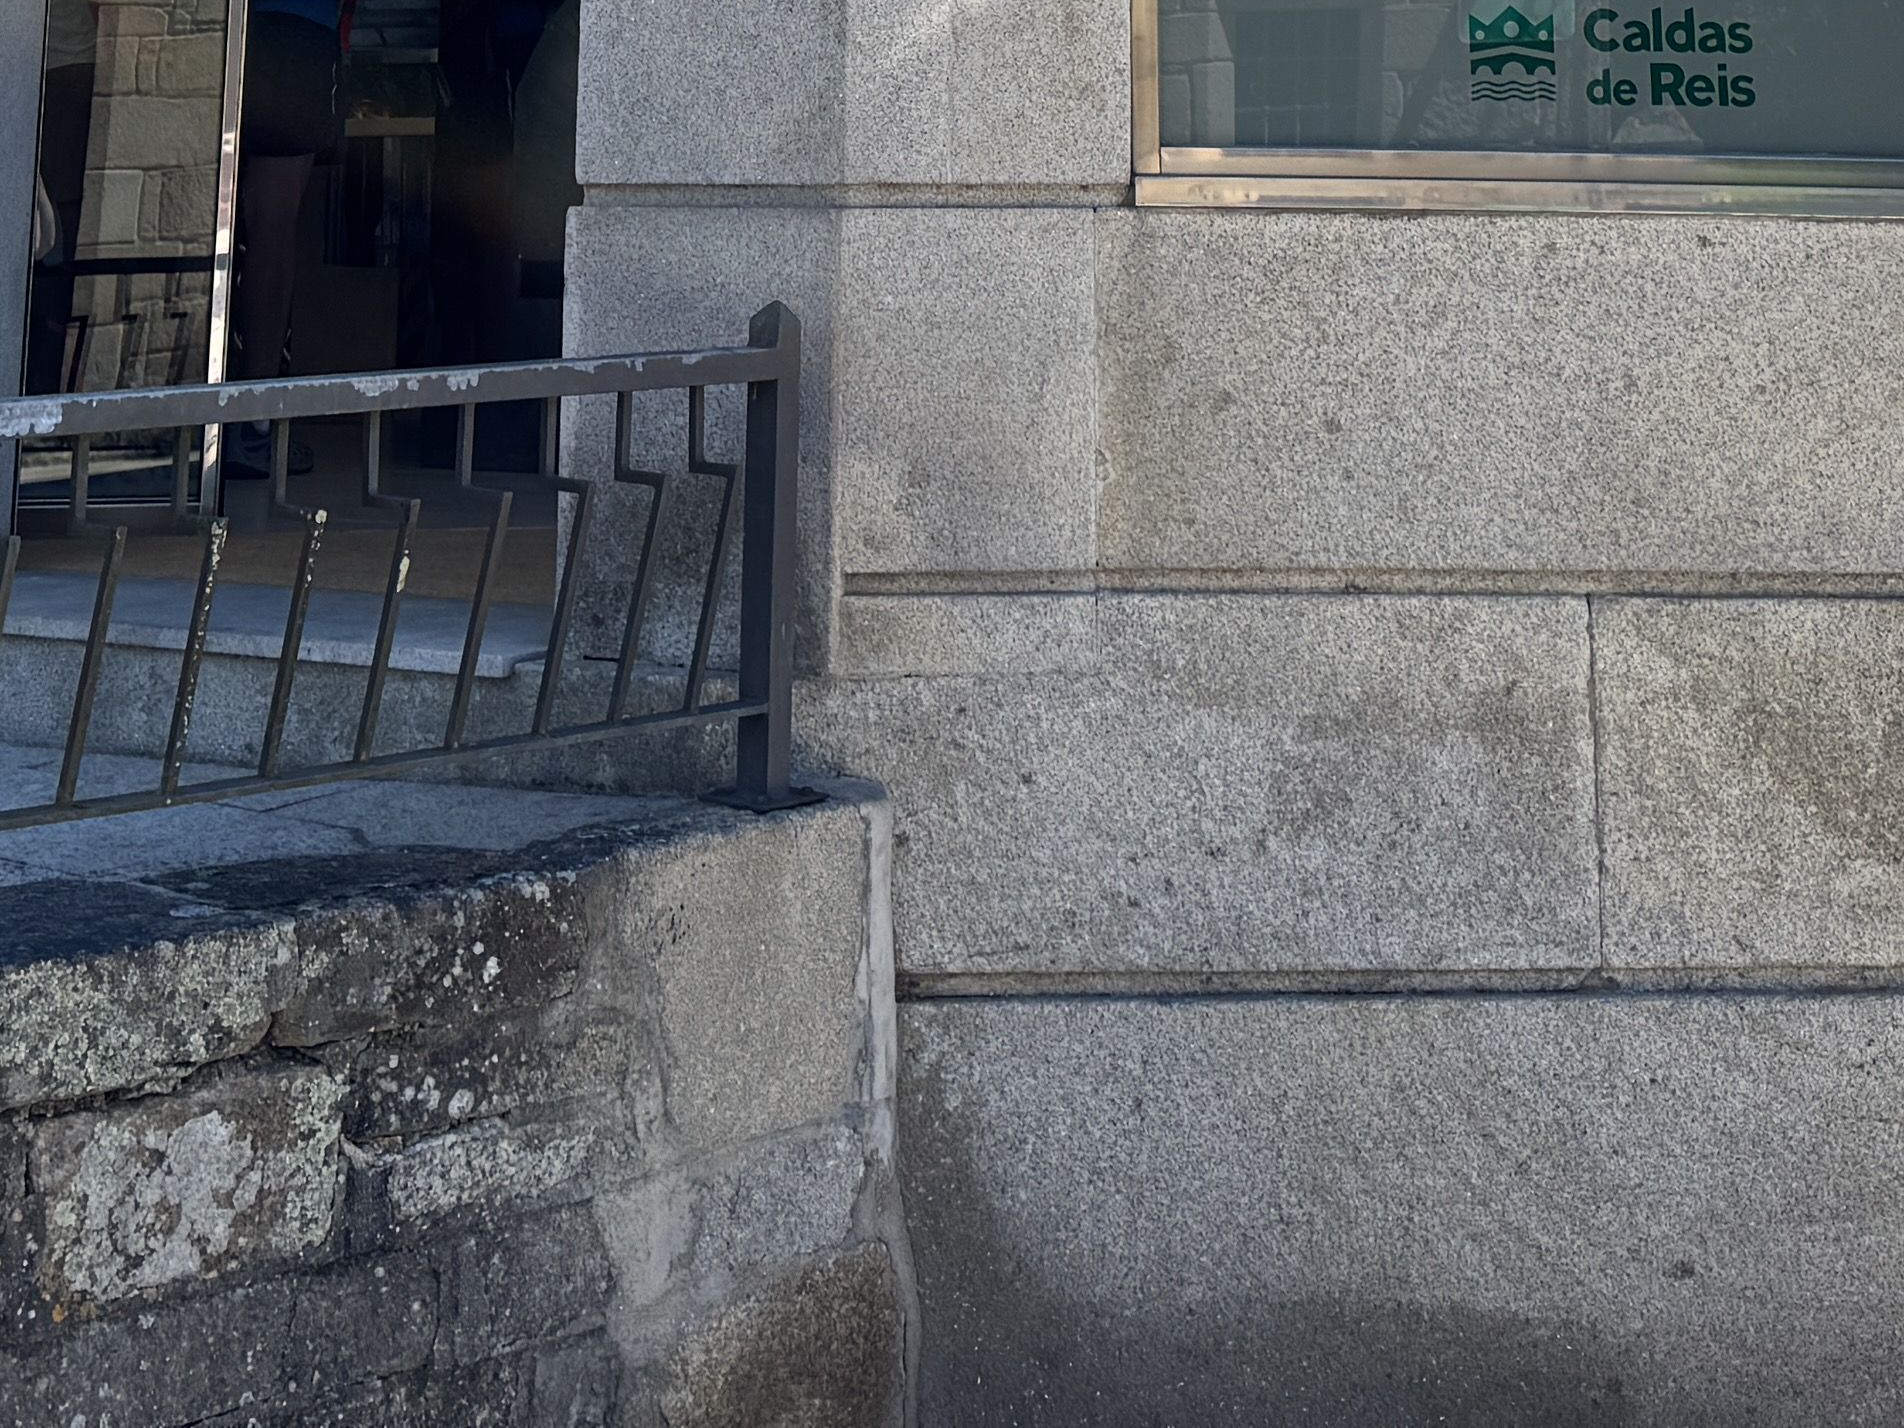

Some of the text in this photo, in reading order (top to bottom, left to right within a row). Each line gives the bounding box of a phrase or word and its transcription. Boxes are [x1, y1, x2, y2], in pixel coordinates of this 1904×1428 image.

[1583, 7, 1754, 54] Caldas
[1586, 63, 1756, 107] de Reis
